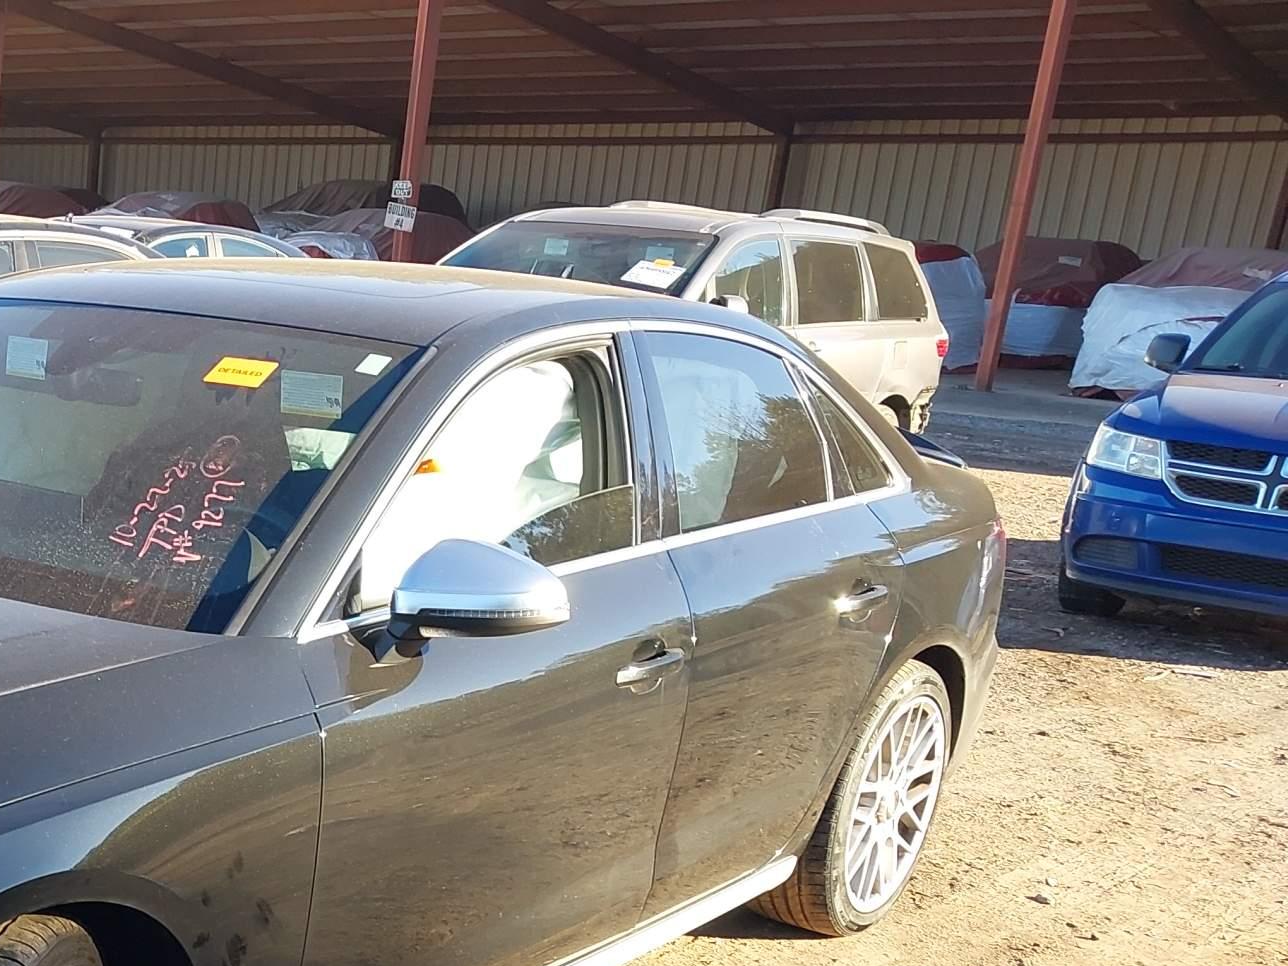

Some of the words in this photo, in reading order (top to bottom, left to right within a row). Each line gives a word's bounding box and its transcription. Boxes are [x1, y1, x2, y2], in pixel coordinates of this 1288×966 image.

[387, 203, 416, 219] BUILDING
[394, 217, 404, 228] #4
[218, 367, 263, 377] DETAILED
[192, 480, 245, 530] 9277
